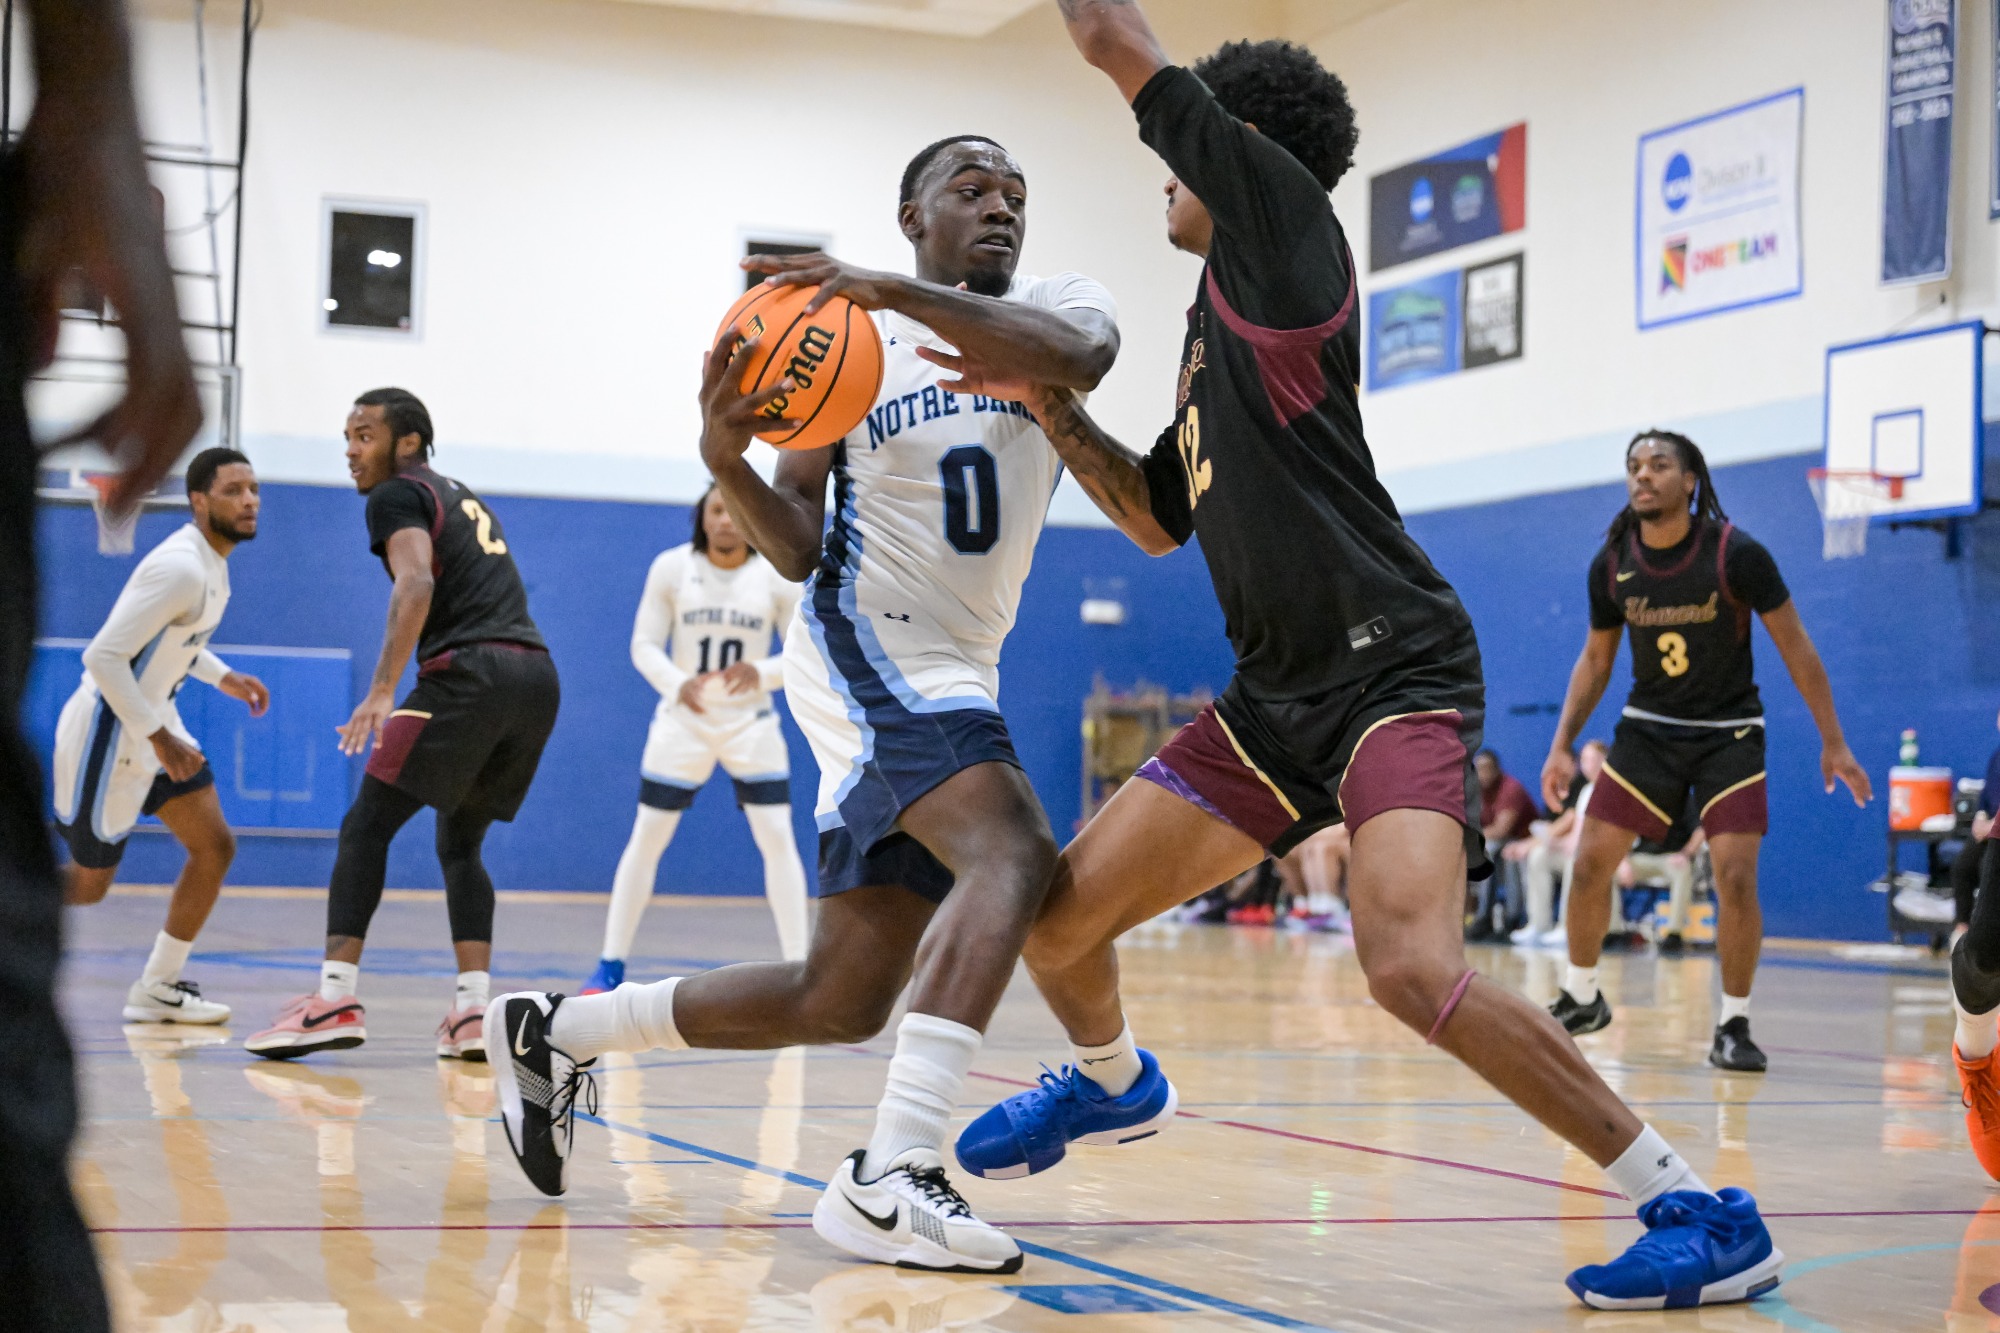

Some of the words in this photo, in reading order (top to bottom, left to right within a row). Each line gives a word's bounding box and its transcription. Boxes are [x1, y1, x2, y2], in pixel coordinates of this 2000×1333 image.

[866, 384, 960, 452] NOTRE
[1177, 405, 1213, 511] 12
[461, 498, 507, 555] 2
[937, 442, 1001, 556] 0
[696, 635, 744, 674] 10
[1373, 625, 1383, 635] L
[1657, 632, 1690, 678] 3
